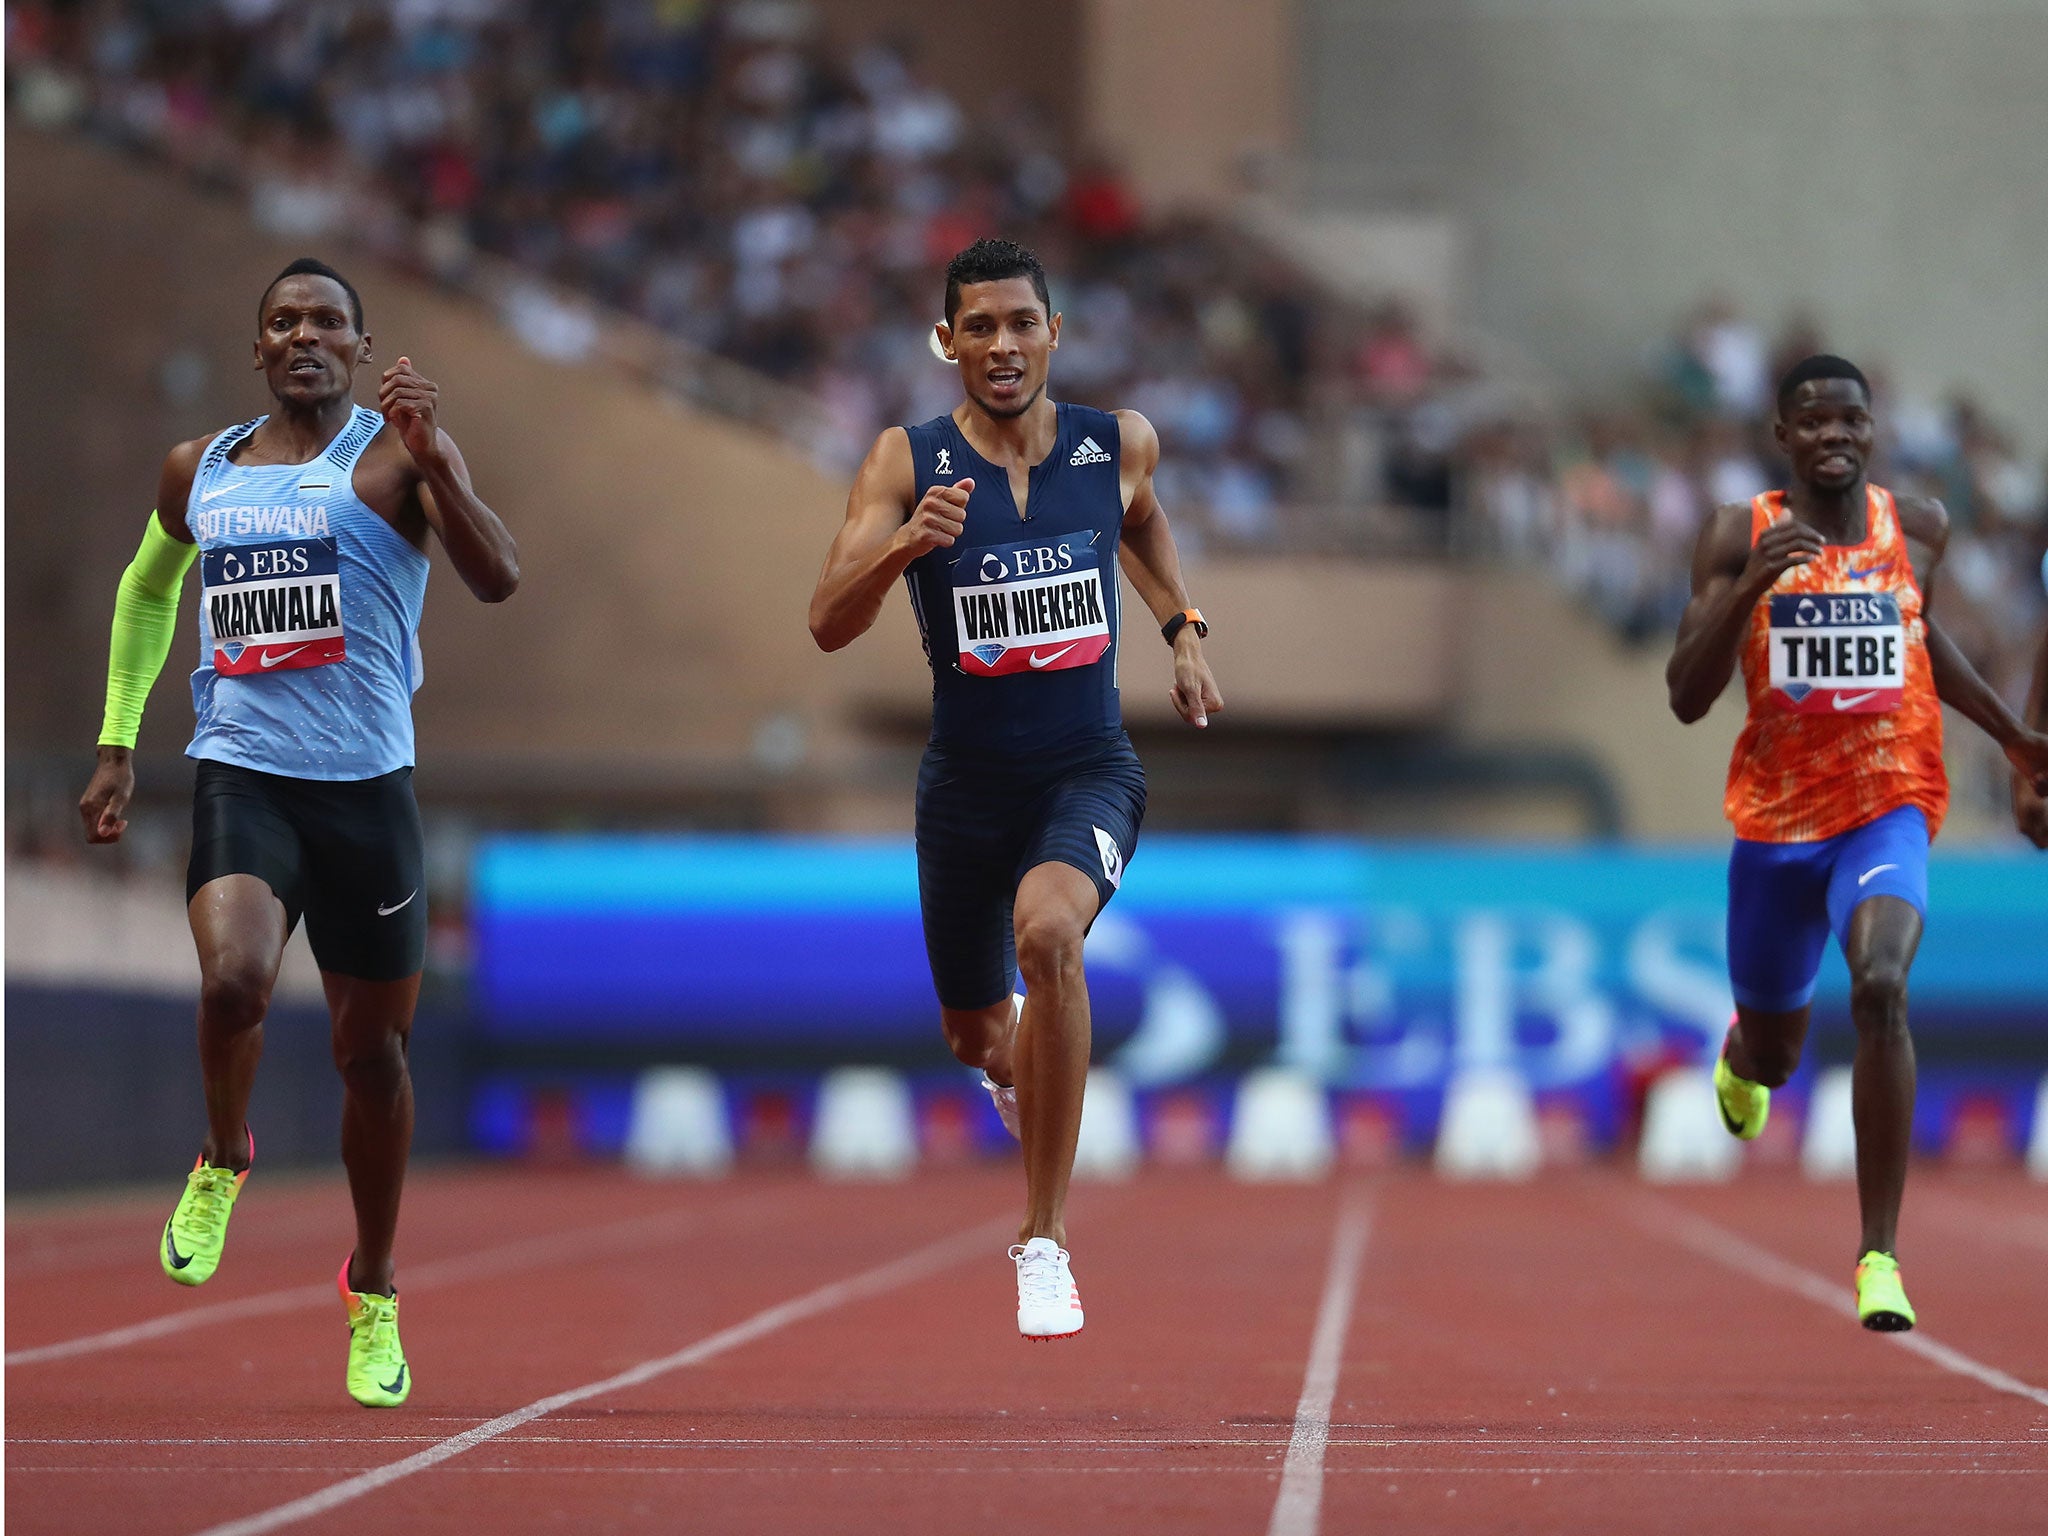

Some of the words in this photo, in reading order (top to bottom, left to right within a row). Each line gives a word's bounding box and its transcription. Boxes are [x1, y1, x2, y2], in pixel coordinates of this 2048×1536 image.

[1070, 453, 1112, 466] adidas
[197, 506, 330, 542] BOTSWANA
[251, 547, 309, 577] EBS
[1013, 543, 1072, 576] EBS
[211, 584, 339, 638] MAXWALA
[961, 592, 1009, 640] VAN
[1013, 578, 1103, 637] NIEKERK
[1828, 598, 1883, 624] EBS
[1781, 636, 1896, 677] THEBE
